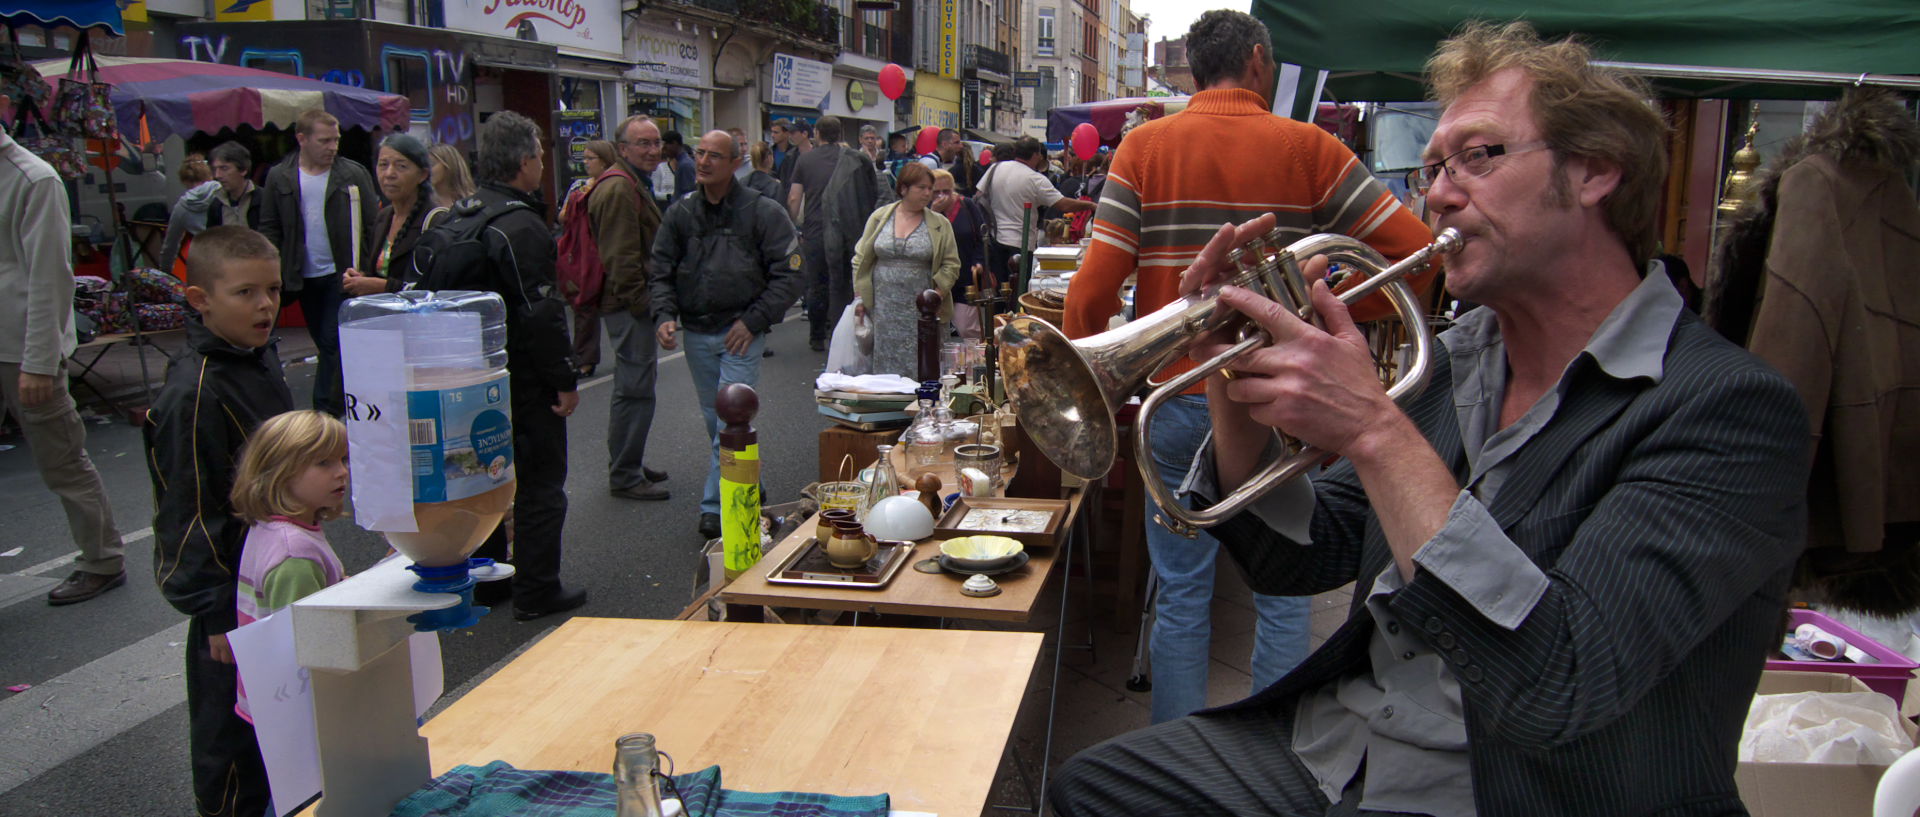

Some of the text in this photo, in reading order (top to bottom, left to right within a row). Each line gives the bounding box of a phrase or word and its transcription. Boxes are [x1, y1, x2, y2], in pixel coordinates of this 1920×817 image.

[182, 35, 229, 63] TV
[434, 49, 465, 82] TV
[447, 85, 468, 105] HD
[449, 392, 462, 402] 5L
